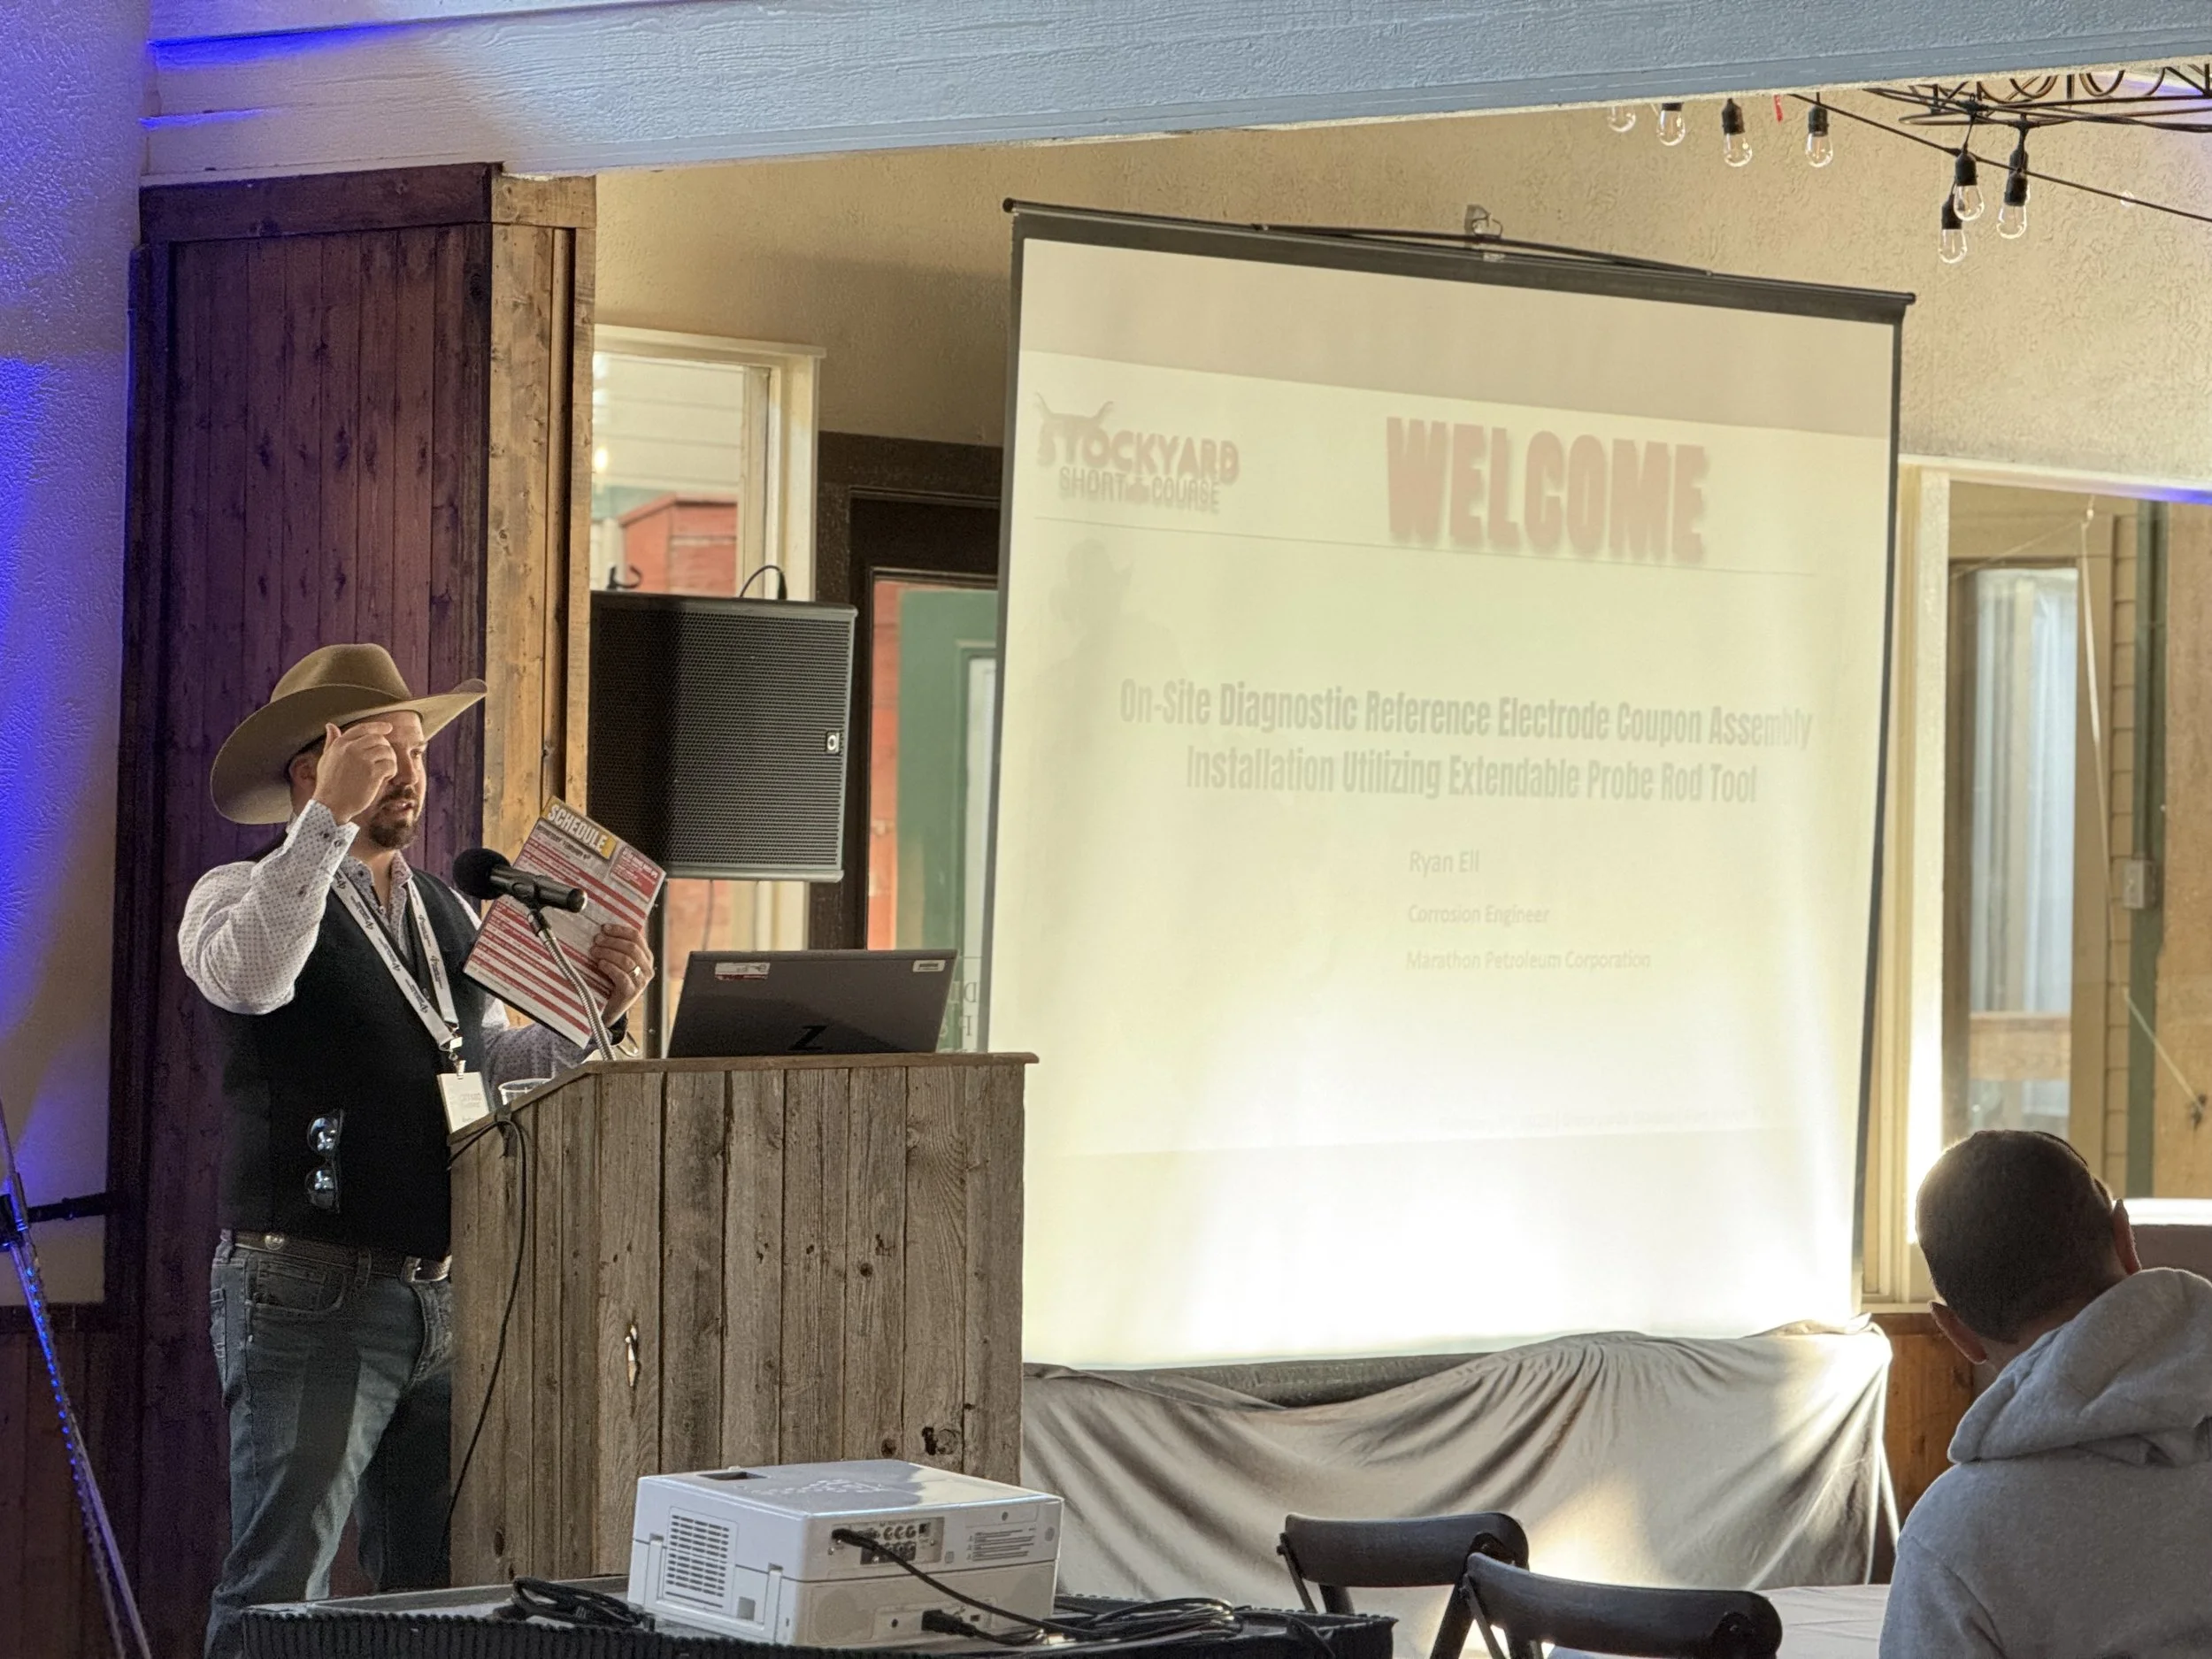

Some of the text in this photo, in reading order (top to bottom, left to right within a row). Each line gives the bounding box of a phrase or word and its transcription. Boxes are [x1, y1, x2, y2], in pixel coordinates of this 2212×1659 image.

[1059, 465, 1221, 513] SHORT COURSE
[1386, 416, 1708, 565] WELCOME
[1119, 678, 1813, 750] On-Site Diagnostic Reference Electrode Coupon Assembly
[1186, 745, 1758, 803] Installation Utilizing Extendable Probe Rod Tool
[548, 803, 608, 853] SCHEDULE
[1409, 849, 1480, 879] Ryan Ell
[1408, 903, 1551, 927] Corrosion Engineer
[1405, 949, 1652, 972] Marathon Petroleum Corporation
